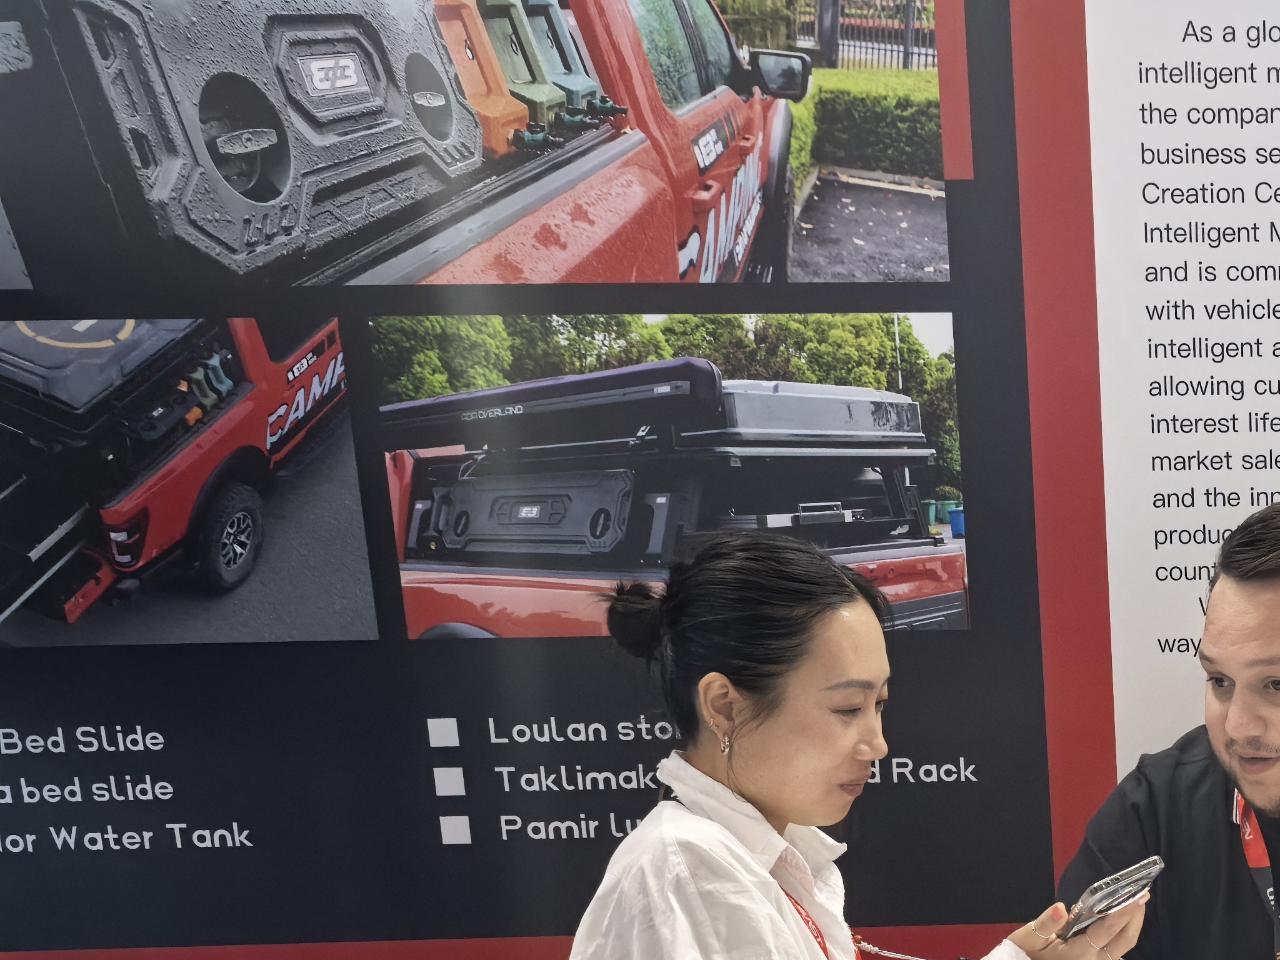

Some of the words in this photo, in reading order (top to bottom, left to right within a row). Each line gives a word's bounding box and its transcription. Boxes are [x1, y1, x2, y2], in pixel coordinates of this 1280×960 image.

[1181, 20, 1213, 43] As
[1222, 25, 1236, 43] a
[1138, 60, 1258, 90] intelligent
[1138, 101, 1178, 125] the
[1140, 141, 1247, 165] business
[1141, 182, 1245, 205] Creation
[1143, 221, 1260, 249] Intelligent
[1144, 260, 1188, 283] and
[1198, 260, 1217, 282] is
[1145, 298, 1195, 321] with
[1147, 336, 1264, 364] intelligent
[1148, 375, 1245, 401] allowing
[1150, 413, 1239, 434] interest
[1151, 449, 1233, 472] market
[1152, 487, 1196, 508] and
[1203, 488, 1241, 508] the
[0, 727, 66, 755] Bed
[75, 725, 165, 753] Slide
[488, 716, 608, 744] Loulan
[617, 714, 682, 742] sto
[494, 763, 659, 792] Taklimak
[891, 756, 979, 784] Rack
[20, 776, 83, 803] bed
[91, 774, 174, 802] slide
[0, 834, 37, 853] or
[49, 824, 154, 850] Water
[165, 821, 254, 849] Tank
[500, 813, 600, 841] Pamir
